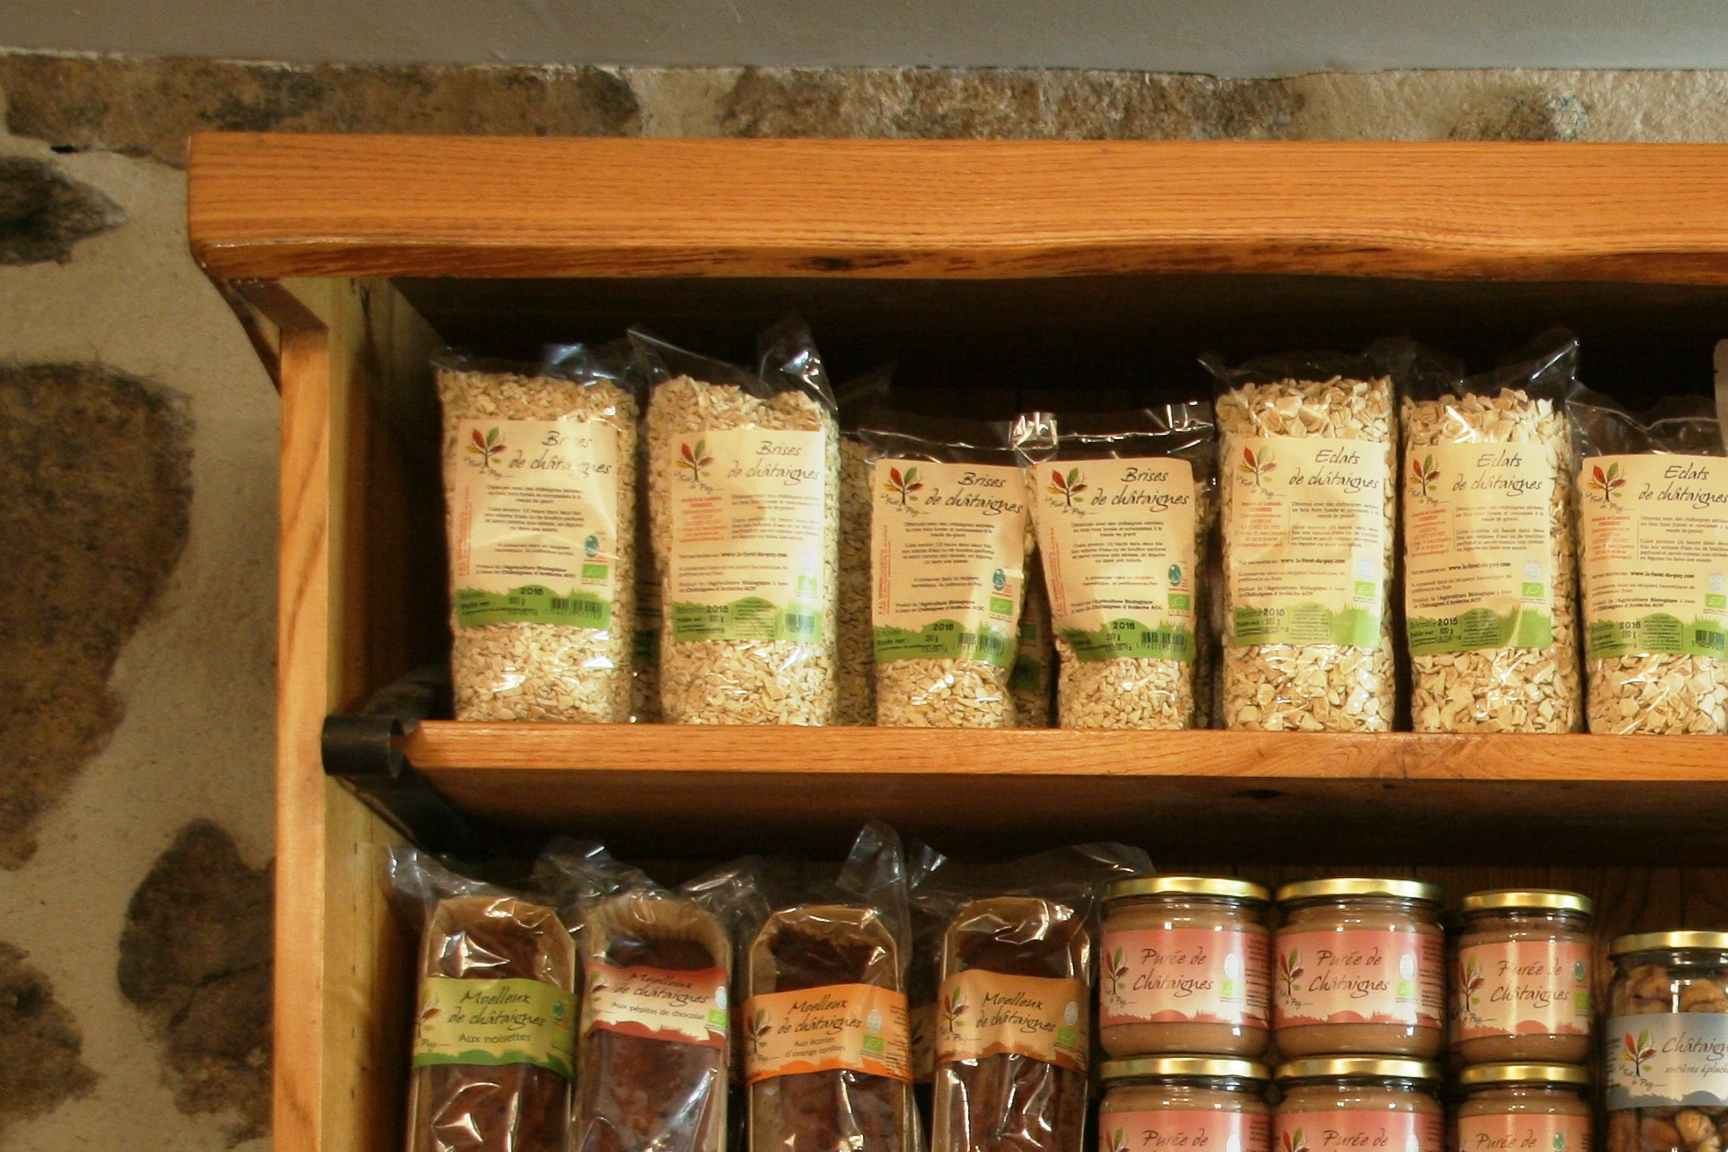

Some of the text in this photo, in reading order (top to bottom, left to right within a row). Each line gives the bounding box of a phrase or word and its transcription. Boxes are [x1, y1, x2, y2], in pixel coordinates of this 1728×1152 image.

[756, 440, 802, 456] Brises
[1315, 447, 1360, 465] Eclats
[1477, 449, 1522, 468] Eclats
[746, 458, 819, 486] châtaignes
[957, 471, 1008, 488] Brises
[1121, 467, 1169, 482] Brises
[1289, 466, 1378, 494] de châtaignes
[1664, 462, 1709, 481] Eclats
[1452, 471, 1542, 497] de châtaignes
[925, 488, 1023, 516] de châtaignes
[1091, 485, 1189, 512] de châtaignes
[1141, 948, 1184, 967] Purée
[1317, 949, 1360, 966] Purée
[629, 972, 694, 989] Moelleux
[1133, 969, 1214, 998] Châtaignes
[460, 986, 531, 1004] Moelleux
[630, 984, 709, 1006] châtaignes
[983, 991, 1044, 1012] Moelleux
[612, 1002, 627, 1010] Aux
[629, 1006, 658, 1015] pépites
[791, 995, 848, 1015] Moelleux
[794, 1015, 861, 1035] châtaignes
[990, 1010, 1057, 1034] châtaignes
[459, 1032, 531, 1044] Aux noisettes
[1143, 1130, 1186, 1147] Purée
[1323, 1130, 1369, 1147] Purée
